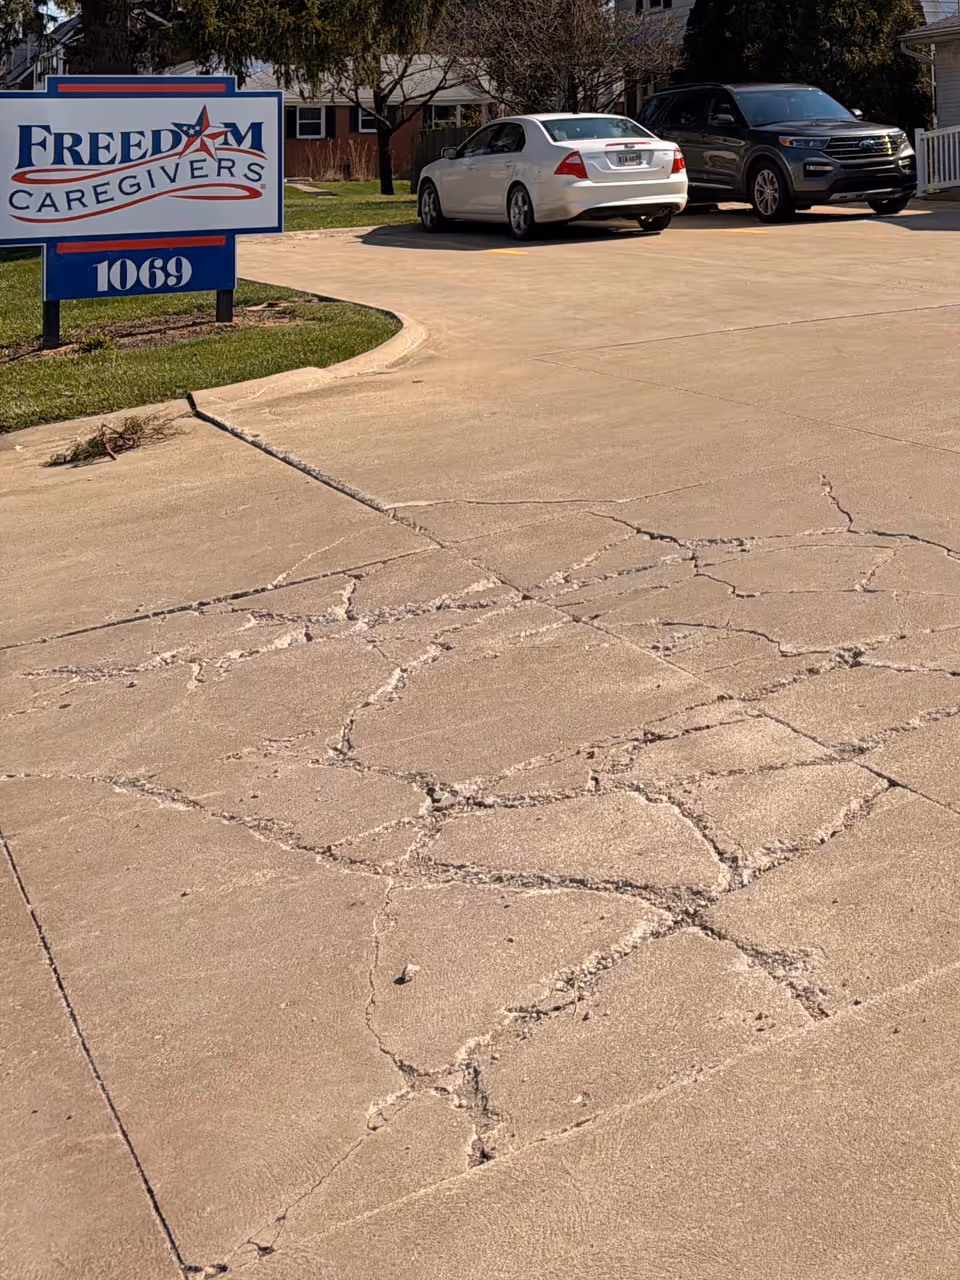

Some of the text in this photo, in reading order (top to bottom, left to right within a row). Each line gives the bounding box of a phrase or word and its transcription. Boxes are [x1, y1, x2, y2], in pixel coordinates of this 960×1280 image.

[15, 104, 267, 170] FREEDM
[8, 158, 267, 213] CAREGIVERS
[93, 255, 193, 292] 1069
